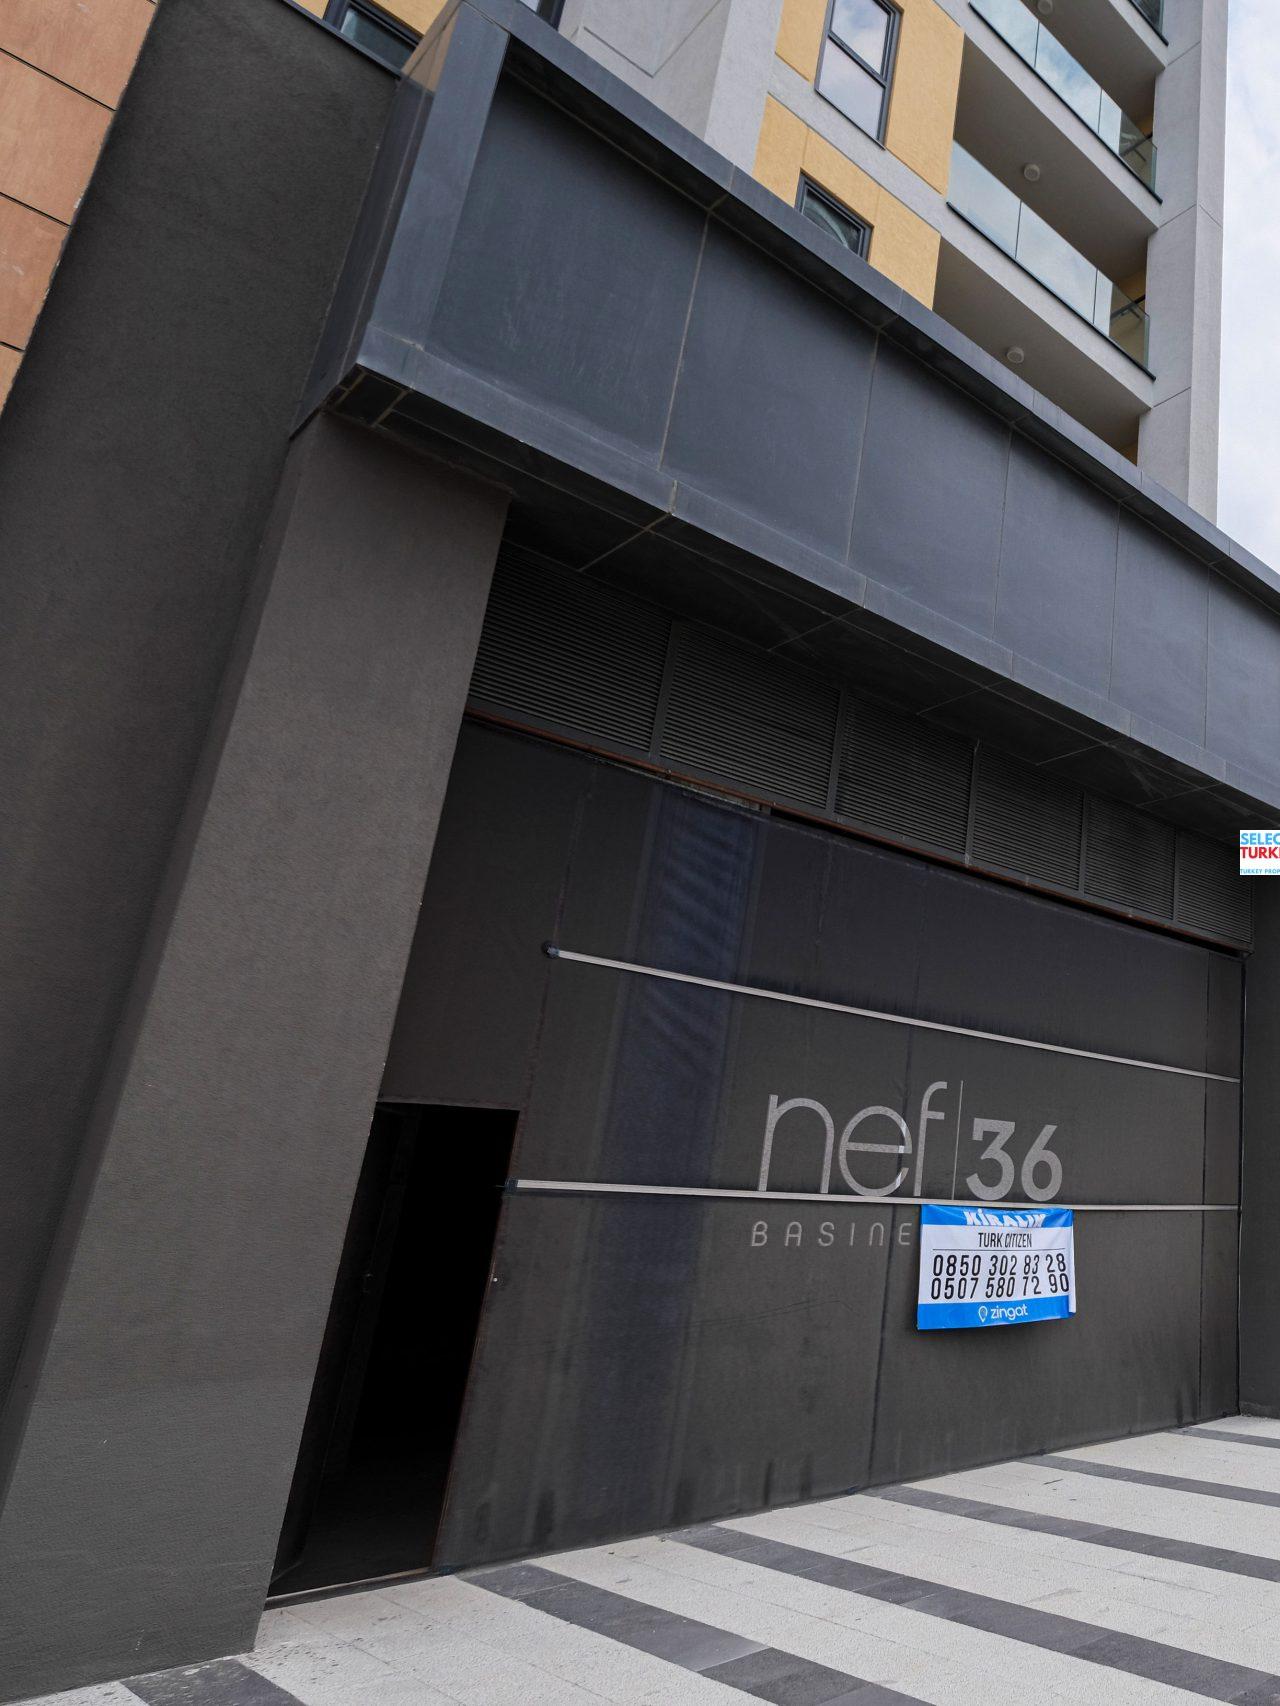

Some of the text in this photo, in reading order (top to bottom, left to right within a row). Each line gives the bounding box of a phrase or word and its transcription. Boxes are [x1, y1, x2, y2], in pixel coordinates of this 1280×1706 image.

[758, 1081, 1063, 1201] nef 36
[978, 1232, 1032, 1248] TURK CITIZEN
[932, 1252, 1067, 1277] 0850 302 83 28
[930, 1273, 1070, 1300] 0507 580 72 90
[990, 1304, 1029, 1320] zingat
